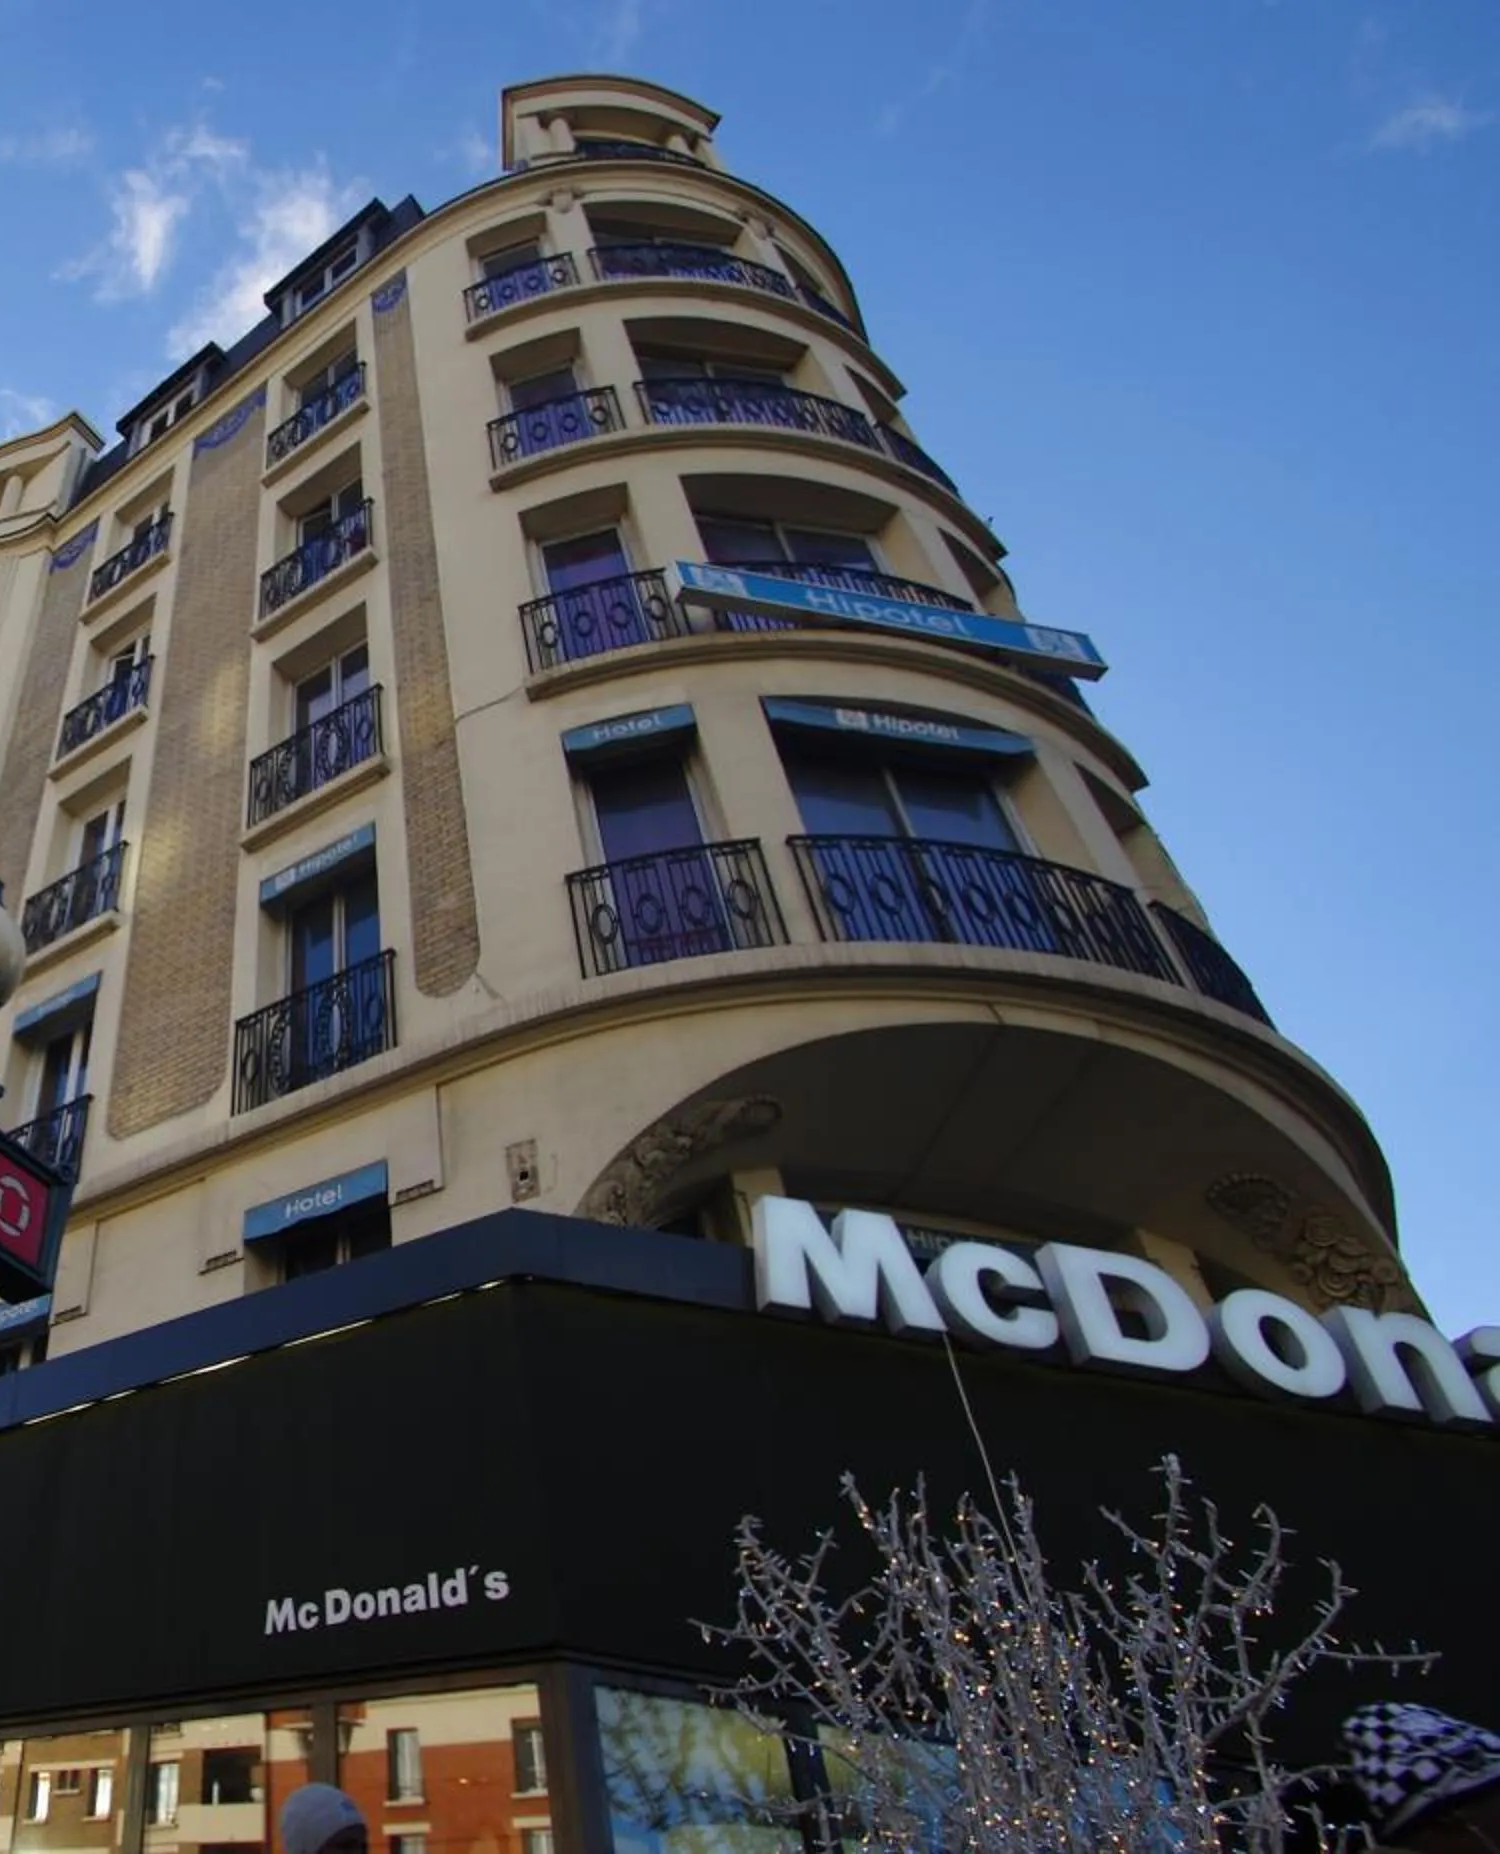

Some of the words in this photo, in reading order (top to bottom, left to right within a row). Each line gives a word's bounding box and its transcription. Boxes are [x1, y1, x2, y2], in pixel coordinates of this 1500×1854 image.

[805, 589, 972, 636] Hipotel
[593, 713, 662, 741] Hotel
[873, 713, 960, 741] Hipotel
[284, 1182, 343, 1219] Hotel
